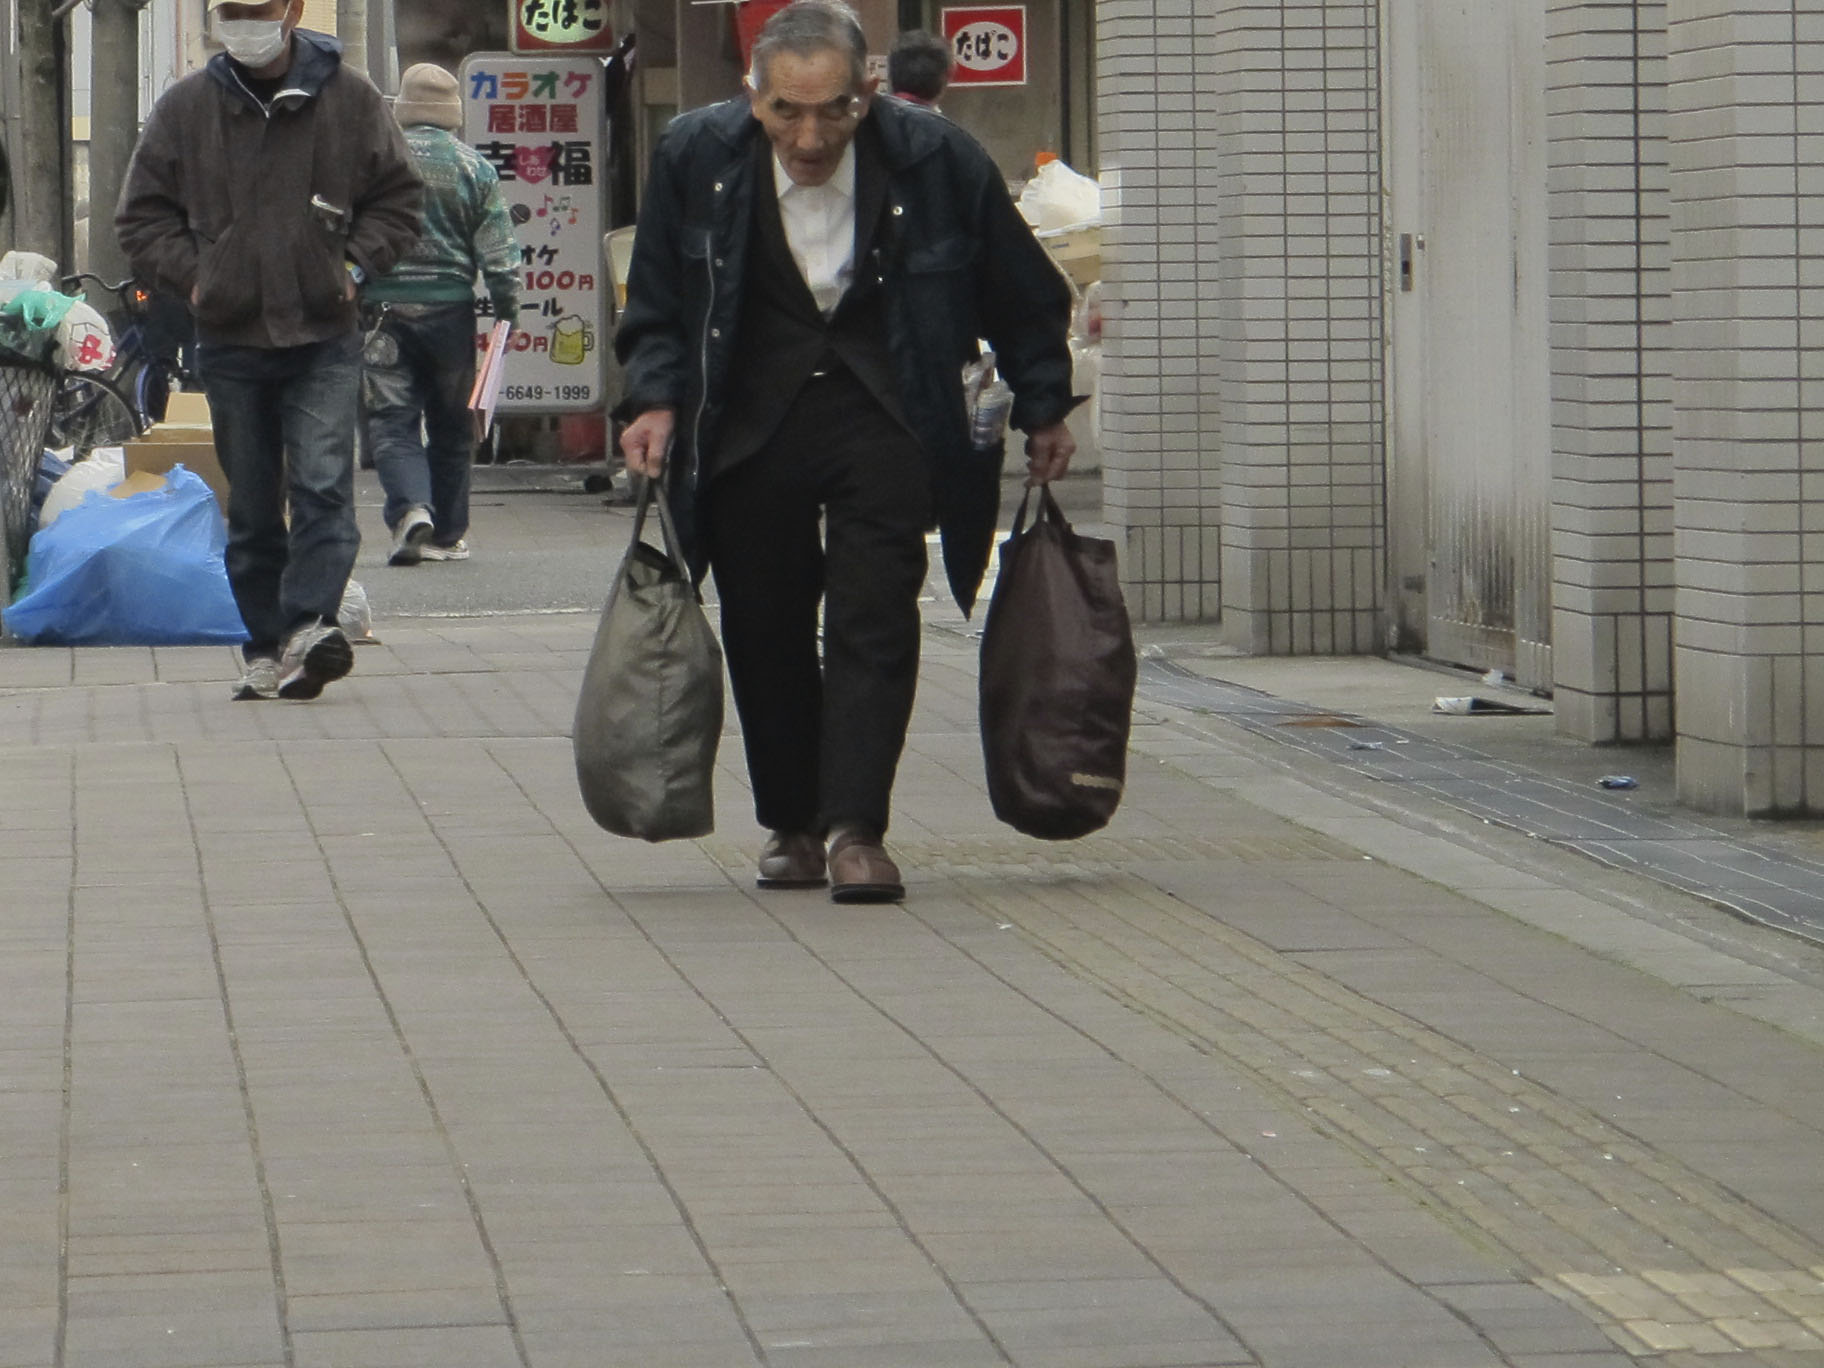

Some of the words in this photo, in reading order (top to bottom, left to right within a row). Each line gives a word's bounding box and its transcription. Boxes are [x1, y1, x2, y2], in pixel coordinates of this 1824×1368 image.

[956, 29, 1010, 62] たばこ
[470, 70, 593, 100] カラオケ
[488, 104, 579, 133] 居酒屋
[474, 296, 564, 318] 生ール
